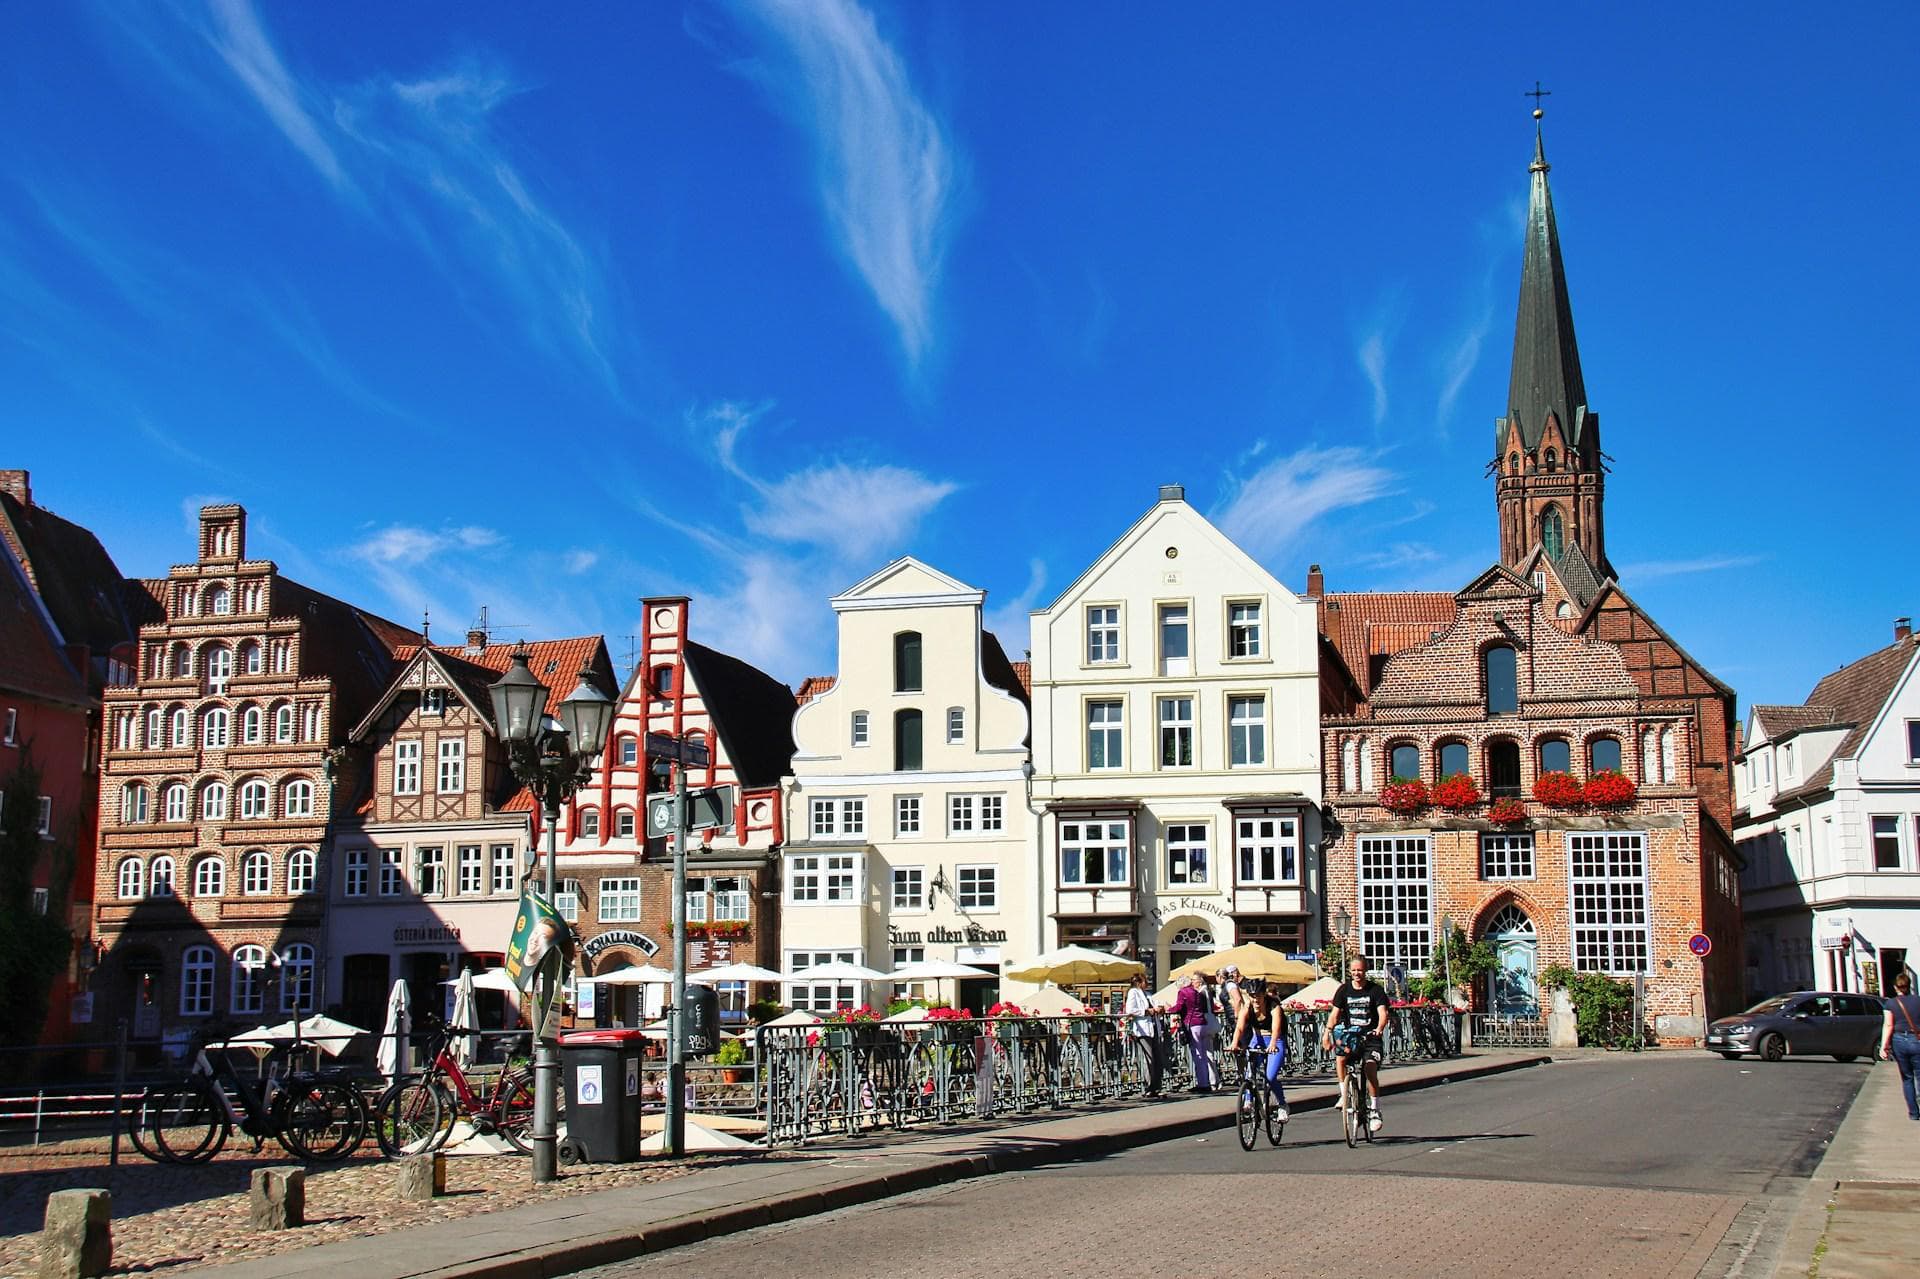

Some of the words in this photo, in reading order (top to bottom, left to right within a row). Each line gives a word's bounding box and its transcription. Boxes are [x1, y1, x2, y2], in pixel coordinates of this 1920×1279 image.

[1150, 901, 1177, 920] DAS
[1180, 897, 1227, 920] KLEINE
[394, 928, 426, 941] OSTERIA
[428, 928, 461, 941] RUSTICA
[586, 932, 654, 954] SCHALLANDER
[886, 924, 922, 944] Zum
[927, 925, 963, 943] alten
